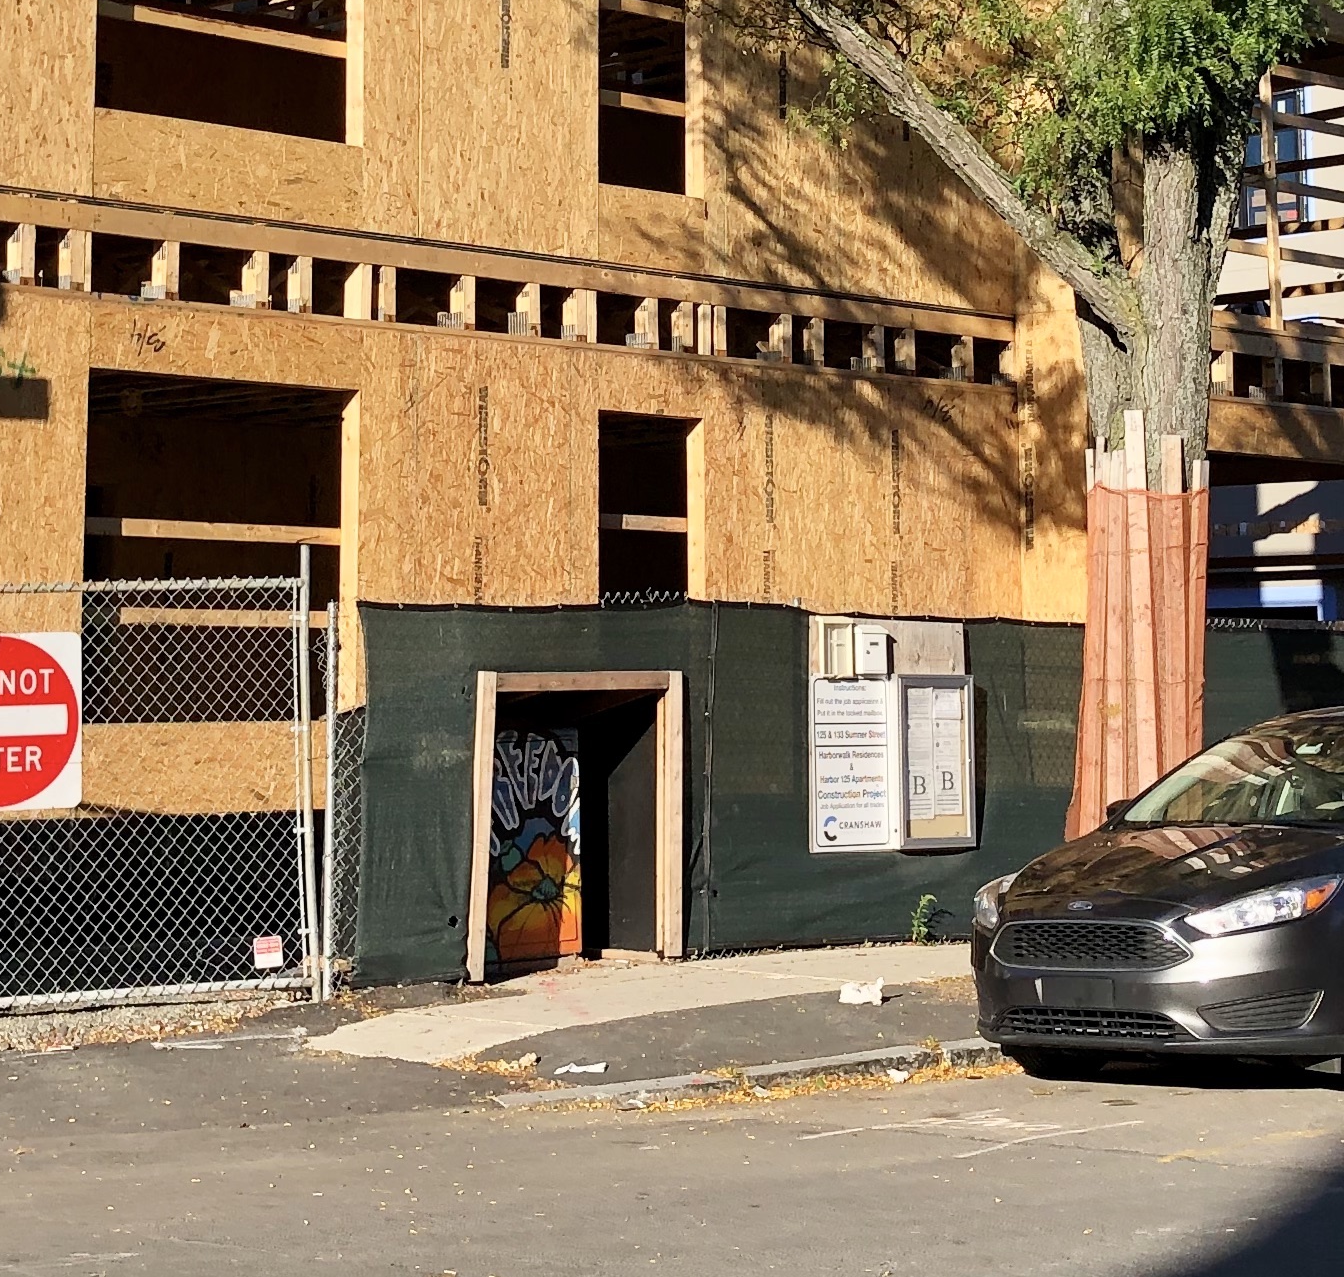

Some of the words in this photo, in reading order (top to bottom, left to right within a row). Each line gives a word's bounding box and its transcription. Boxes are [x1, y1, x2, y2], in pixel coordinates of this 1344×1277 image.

[817, 731, 827, 739] 125
[834, 731, 844, 739] 133
[868, 730, 885, 738] Street
[818, 751, 850, 759] Harborwalk
[852, 751, 884, 759] Residences
[820, 775, 839, 783] Harbor
[841, 775, 851, 783] 125
[852, 775, 884, 784] Apartments
[941, 771, 954, 791] B
[913, 775, 927, 795] B
[818, 789, 861, 799] Construction
[862, 789, 886, 800] Project
[839, 820, 882, 830] CRANSHAW
